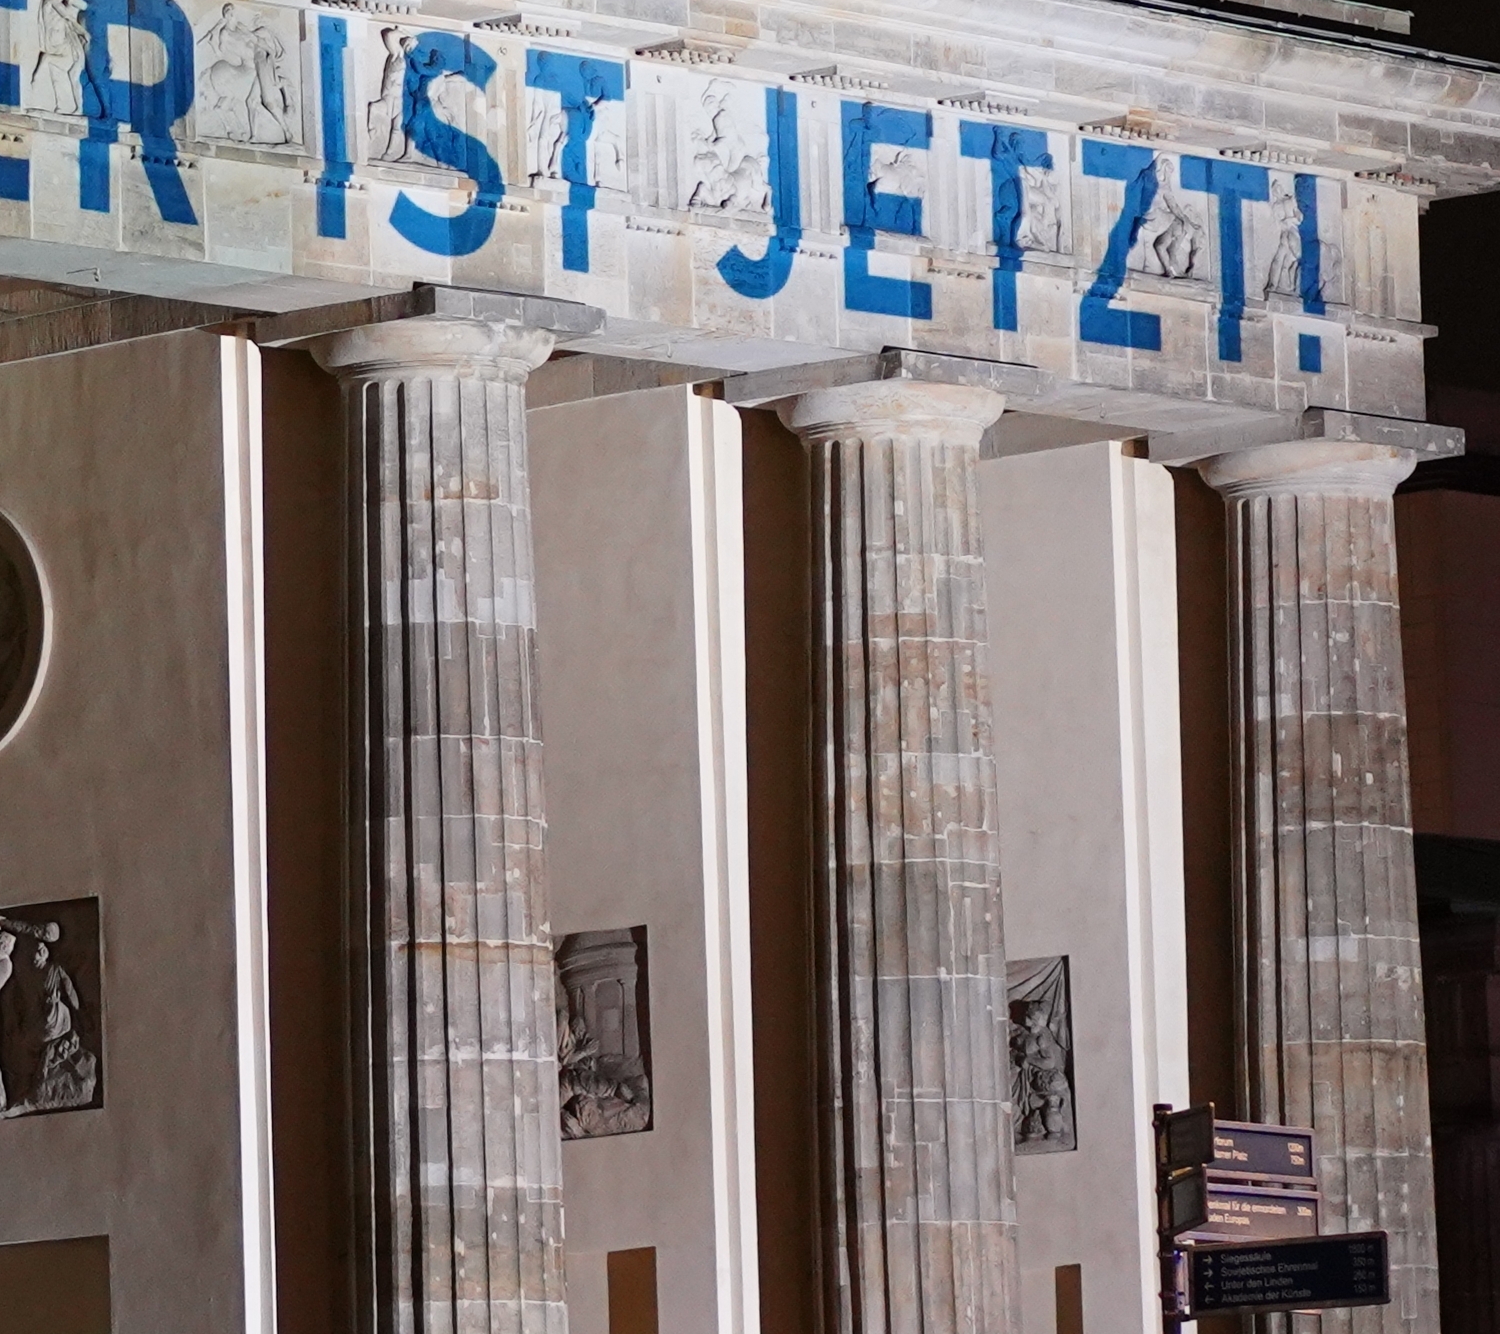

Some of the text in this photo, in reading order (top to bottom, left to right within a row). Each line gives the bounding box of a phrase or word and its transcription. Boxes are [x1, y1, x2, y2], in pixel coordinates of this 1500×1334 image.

[317, 14, 625, 274] IST
[715, 85, 1323, 373] JETZT!
[1220, 1279, 1244, 1290] Unter
[1246, 1278, 1263, 1289] den
[1264, 1276, 1294, 1288] Linden
[1221, 1290, 1263, 1303] Akademie
[1265, 1290, 1280, 1301] der
[1281, 1287, 1312, 1299] Künste
